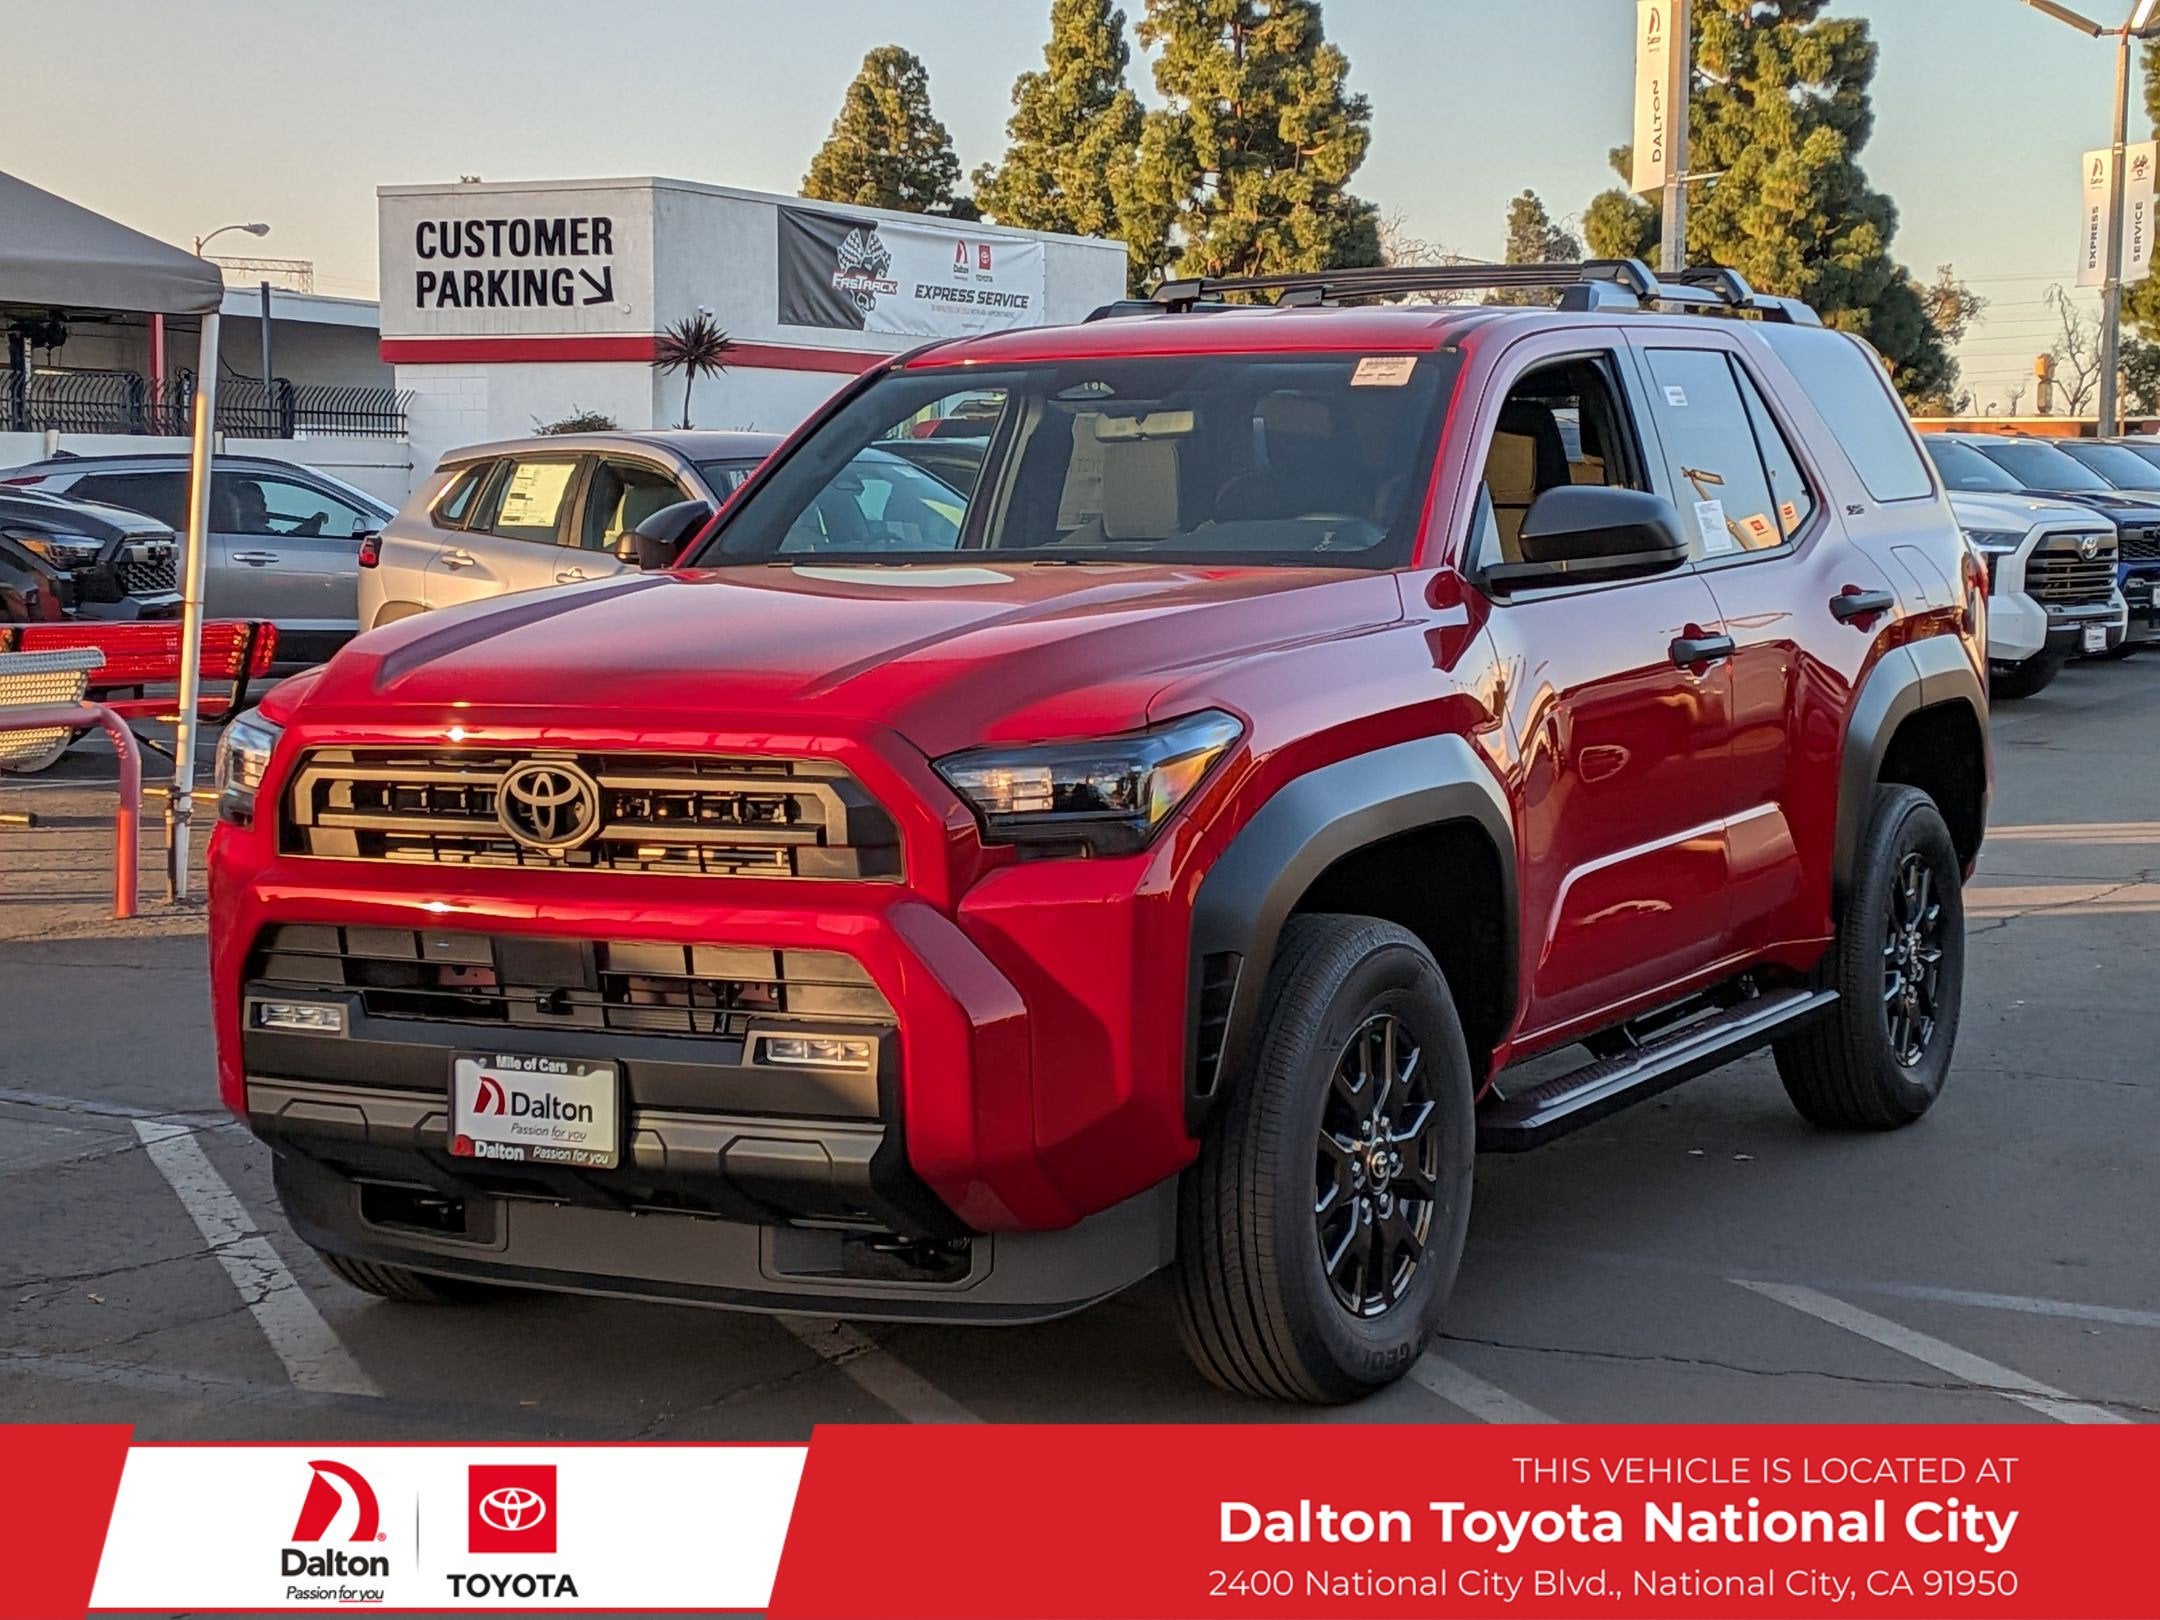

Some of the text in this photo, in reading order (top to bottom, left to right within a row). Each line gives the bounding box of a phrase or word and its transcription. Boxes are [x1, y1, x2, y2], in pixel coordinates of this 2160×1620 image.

[1652, 80, 1662, 163] DALTON
[416, 217, 613, 260] CUSTOMER
[2088, 206, 2099, 269] EXPRESS
[2133, 201, 2143, 262] SERVICE
[416, 268, 574, 308] PARKING
[914, 284, 1029, 309] EXPRESS SERVICE
[495, 1055, 568, 1073] Mile of Cars
[511, 1091, 593, 1123] Dalton
[510, 1123, 587, 1141] Passion for you
[475, 1140, 609, 1165] Dalton Passion for you
